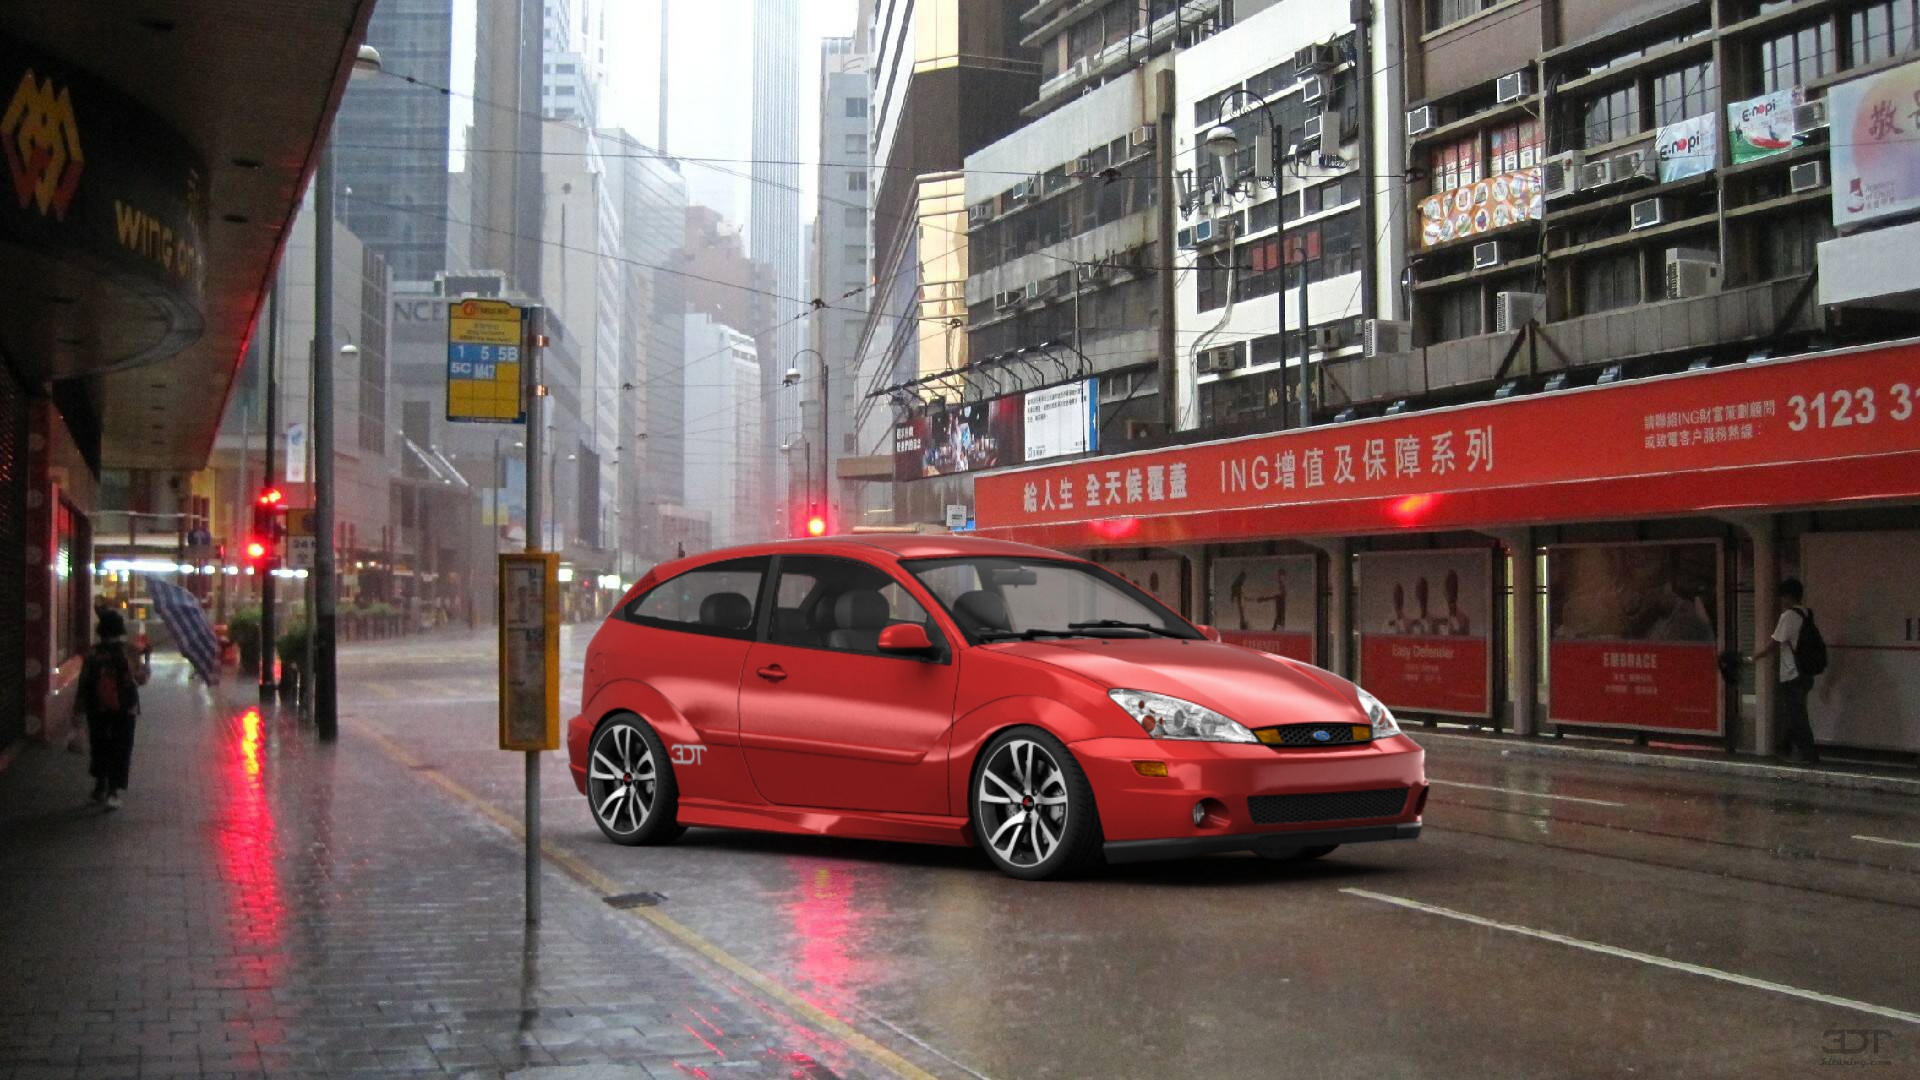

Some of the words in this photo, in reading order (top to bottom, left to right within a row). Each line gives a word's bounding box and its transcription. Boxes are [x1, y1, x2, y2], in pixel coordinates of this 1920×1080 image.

[458, 345, 465, 358] 1
[480, 345, 490, 361] 5
[498, 346, 518, 361] 5B
[451, 362, 472, 374] 5C
[475, 364, 496, 379] M47
[1786, 381, 1876, 432] 3123
[1889, 382, 1920, 421] 3
[1086, 462, 1188, 507] 全天候覆蓋
[1602, 652, 1658, 669] EMBRACE
[671, 743, 708, 766] 3DT
